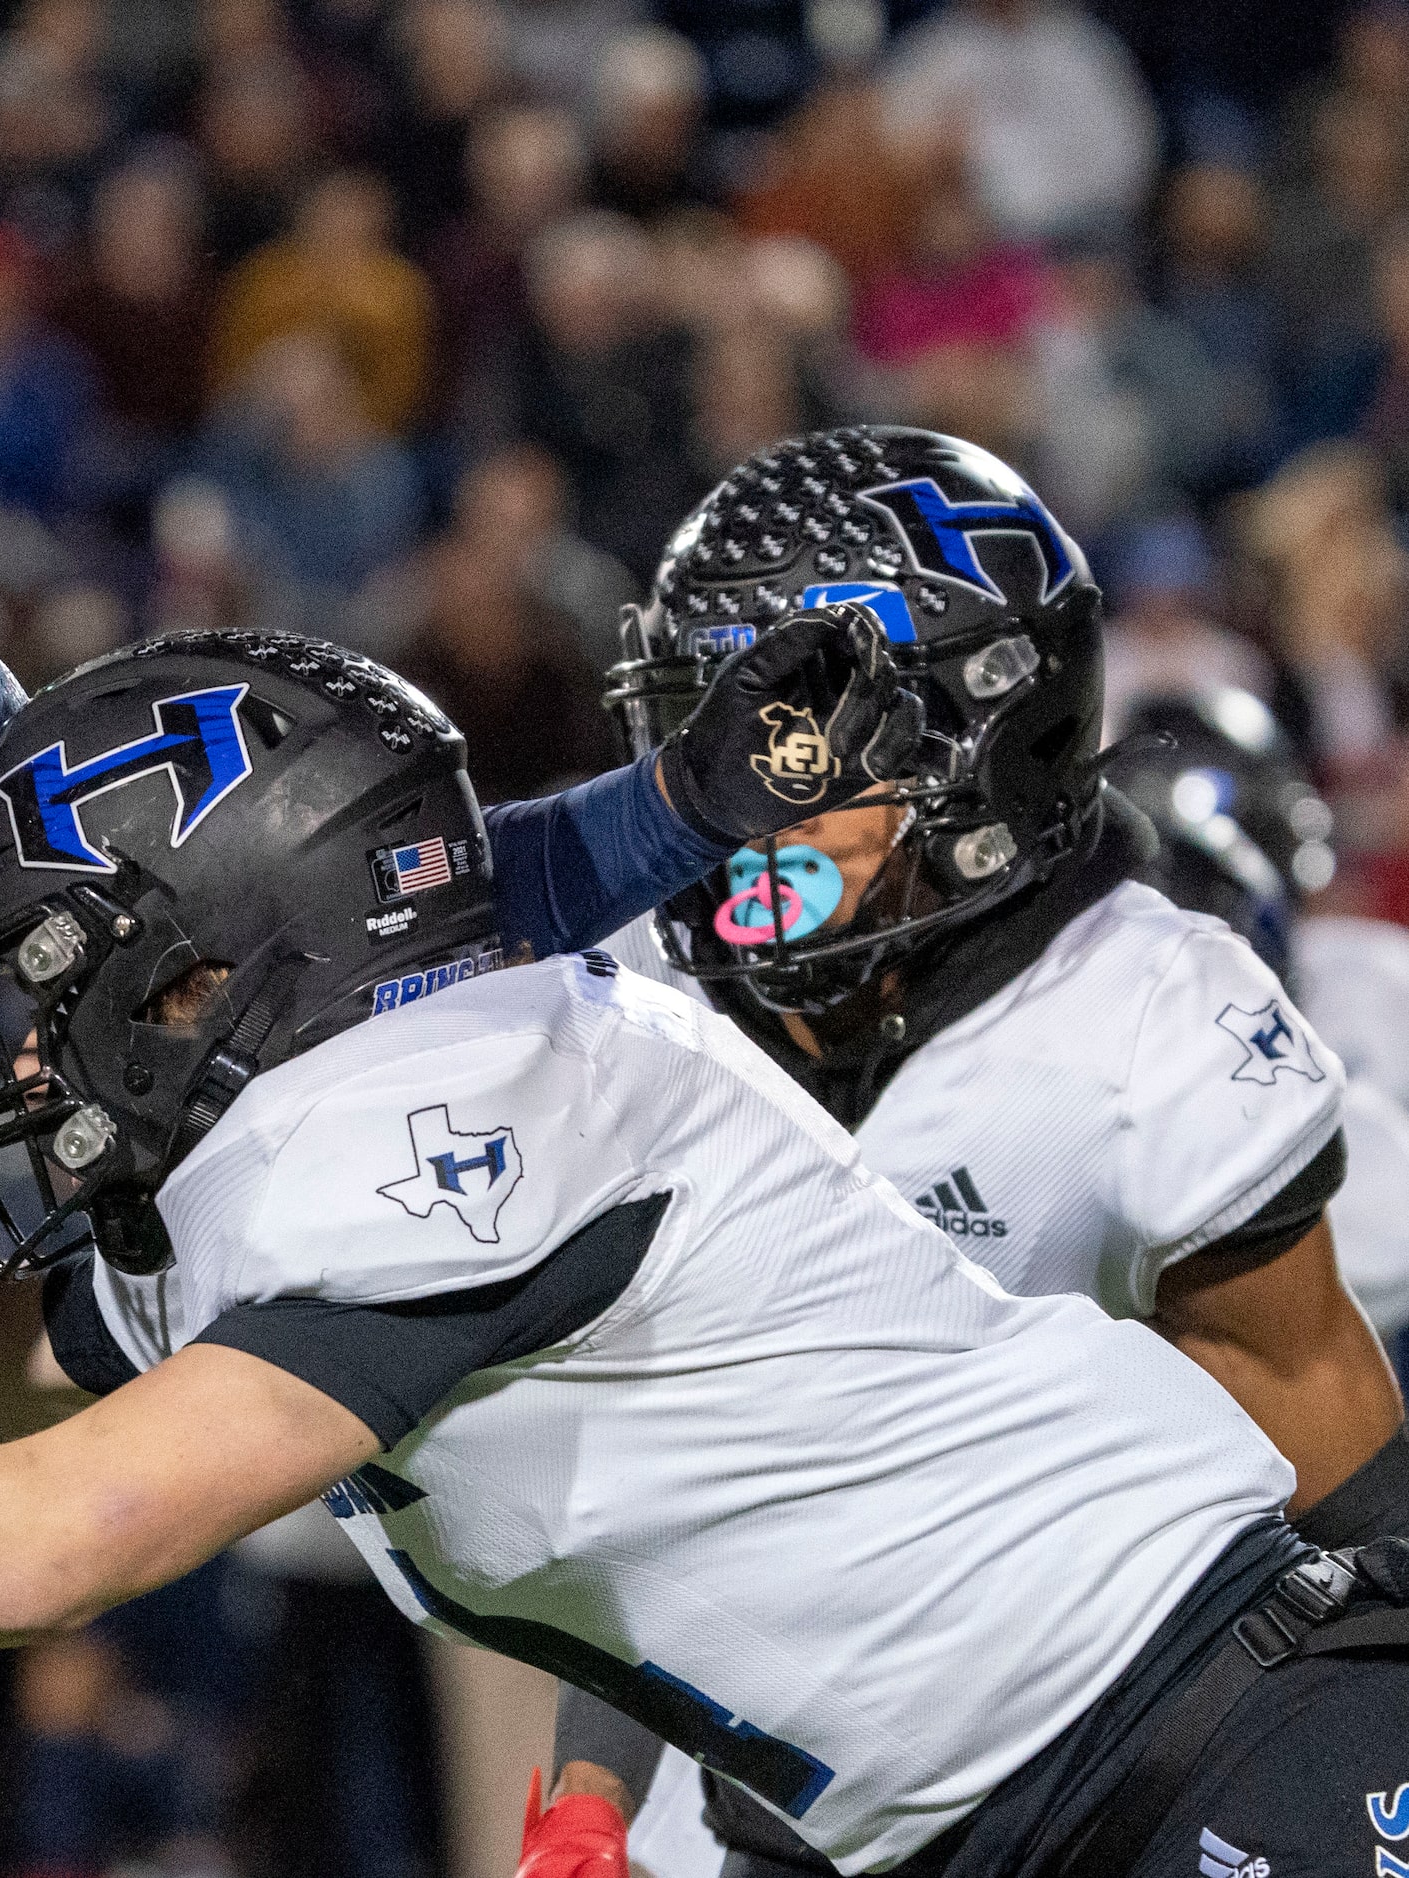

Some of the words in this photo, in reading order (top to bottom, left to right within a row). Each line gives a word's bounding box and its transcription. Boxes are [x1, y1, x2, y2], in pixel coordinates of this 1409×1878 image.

[365, 907, 414, 932] Riddell
[378, 921, 409, 937] MEDIUM
[923, 1206, 1009, 1238] didas
